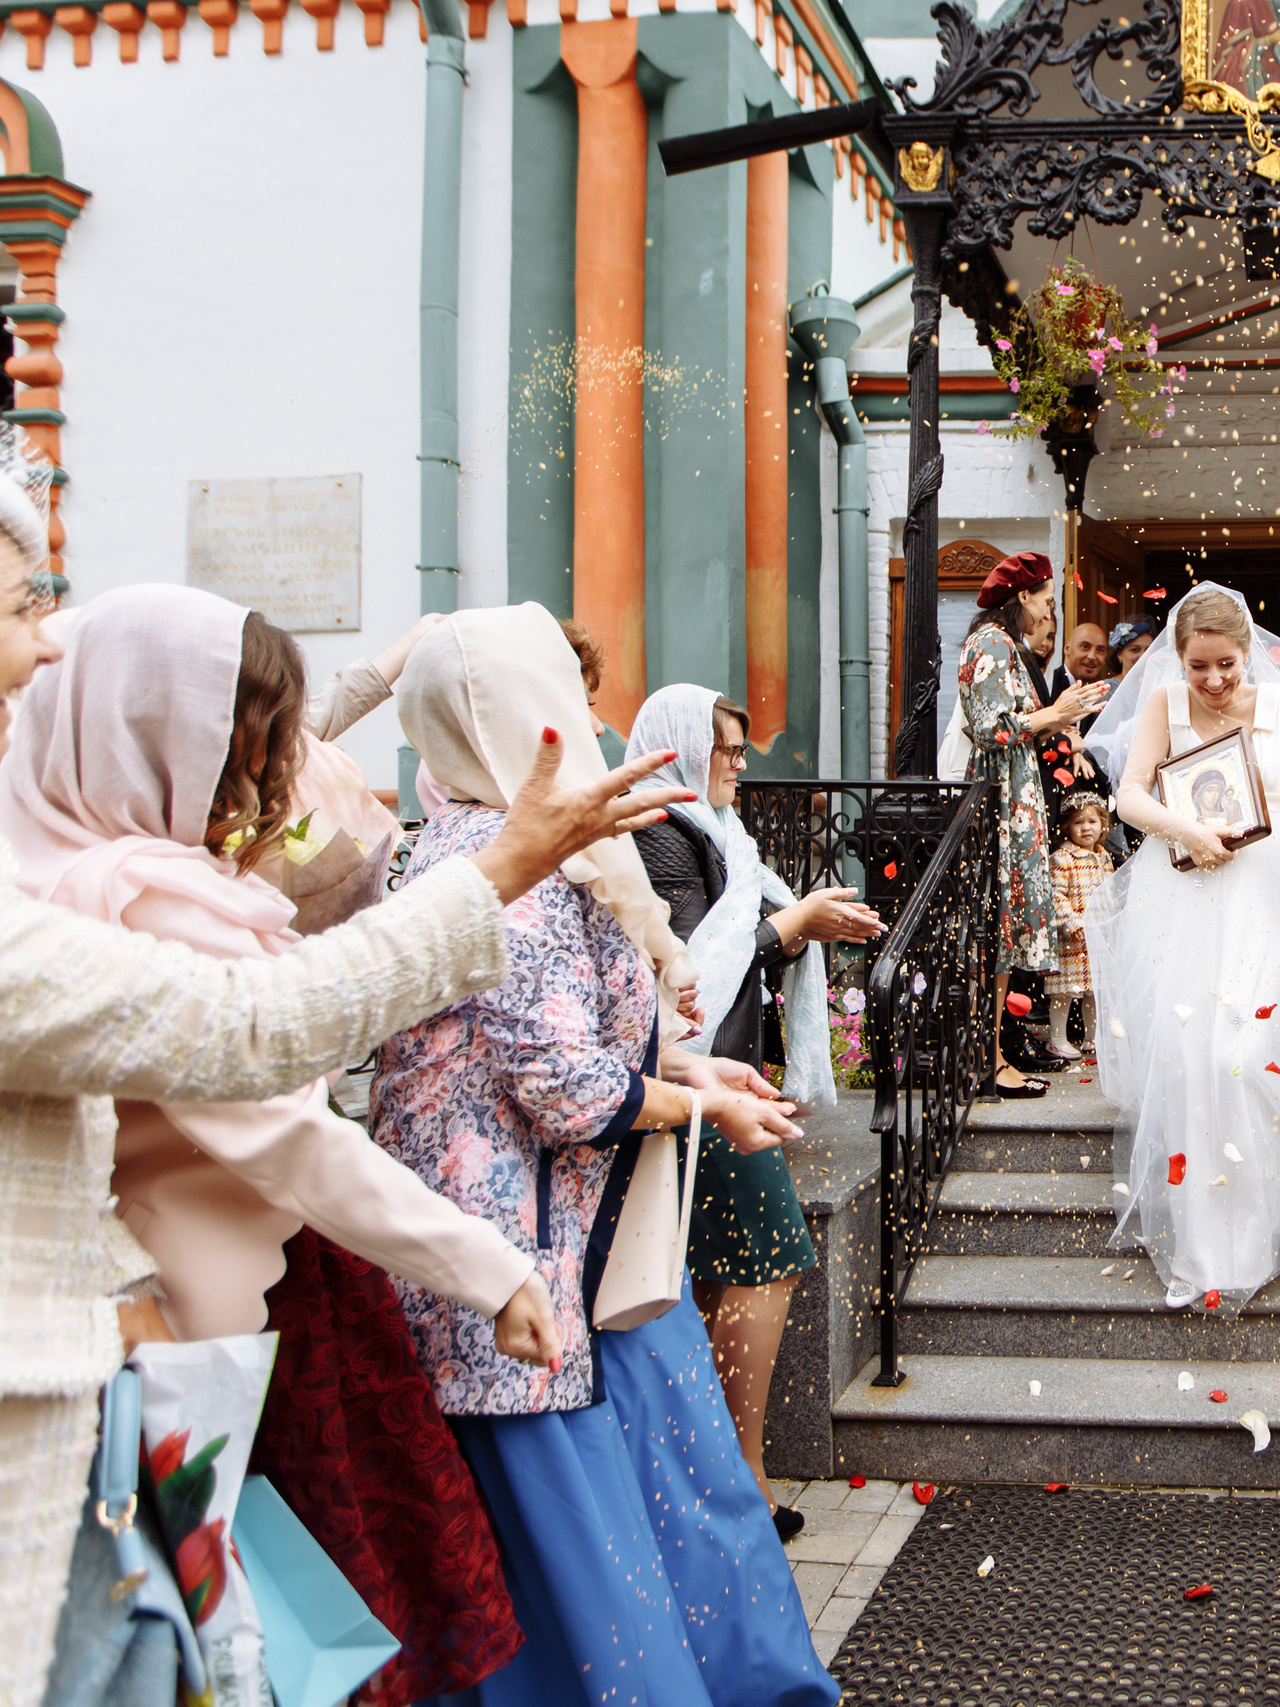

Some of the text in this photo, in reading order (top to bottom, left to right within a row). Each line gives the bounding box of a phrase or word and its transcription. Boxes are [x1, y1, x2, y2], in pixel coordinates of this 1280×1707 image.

[193, 522, 352, 540] ЦЕРКОВЬ НИКОЛЫ
[192, 540, 352, 557] В ХАМОВНИКАХ
